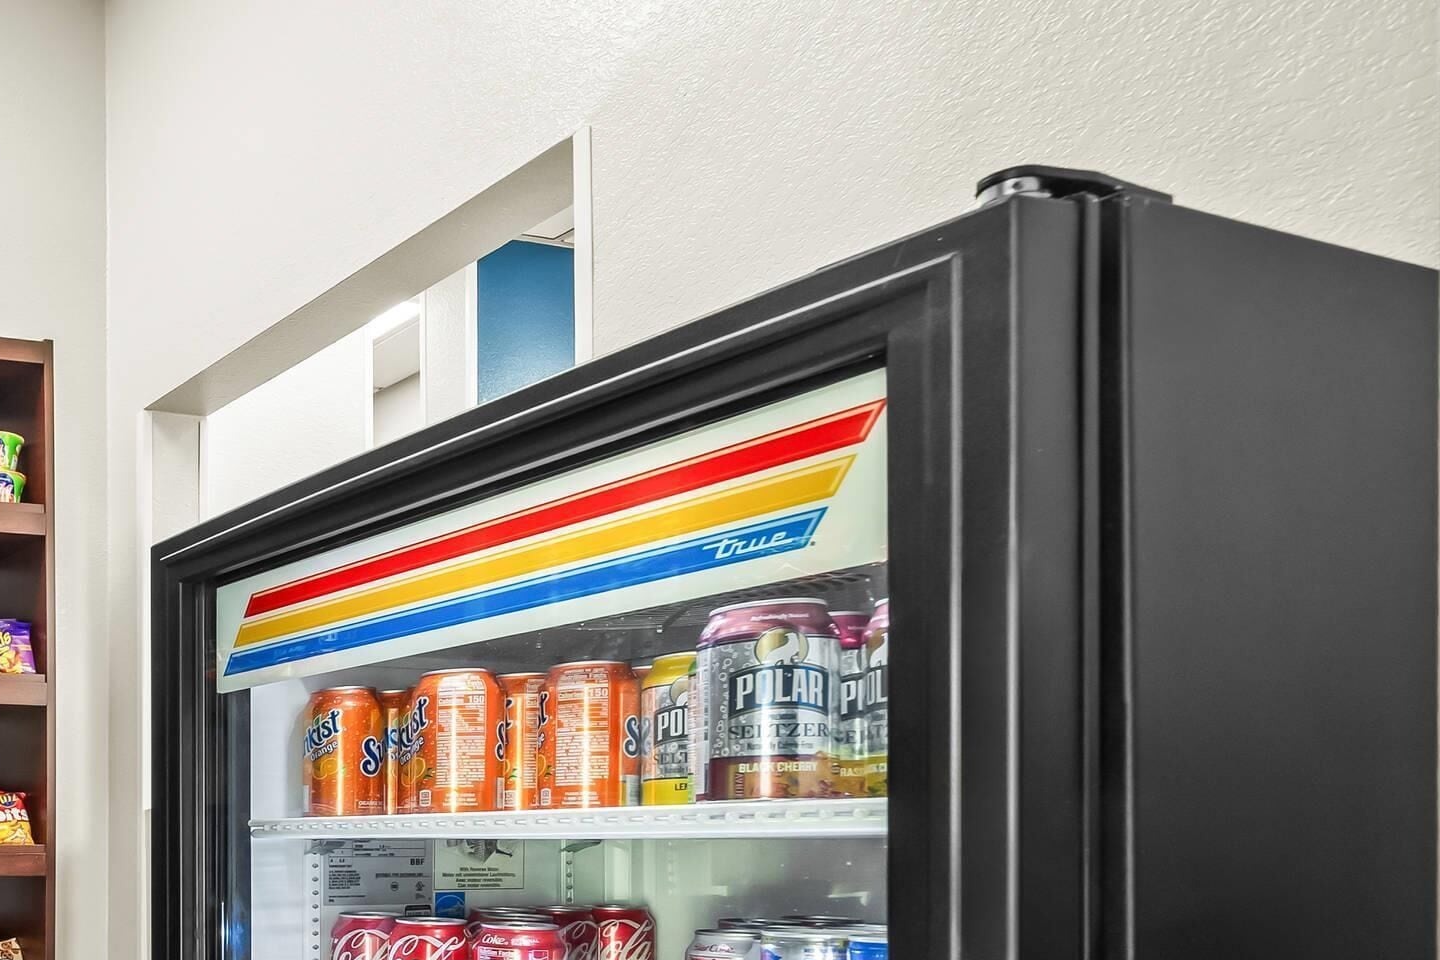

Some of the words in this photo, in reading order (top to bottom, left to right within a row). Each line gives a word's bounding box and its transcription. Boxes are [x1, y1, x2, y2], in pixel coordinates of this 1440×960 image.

[702, 531, 794, 560] true
[467, 695, 485, 704] 150
[735, 668, 824, 711] POLAR
[482, 933, 506, 945] Coke
